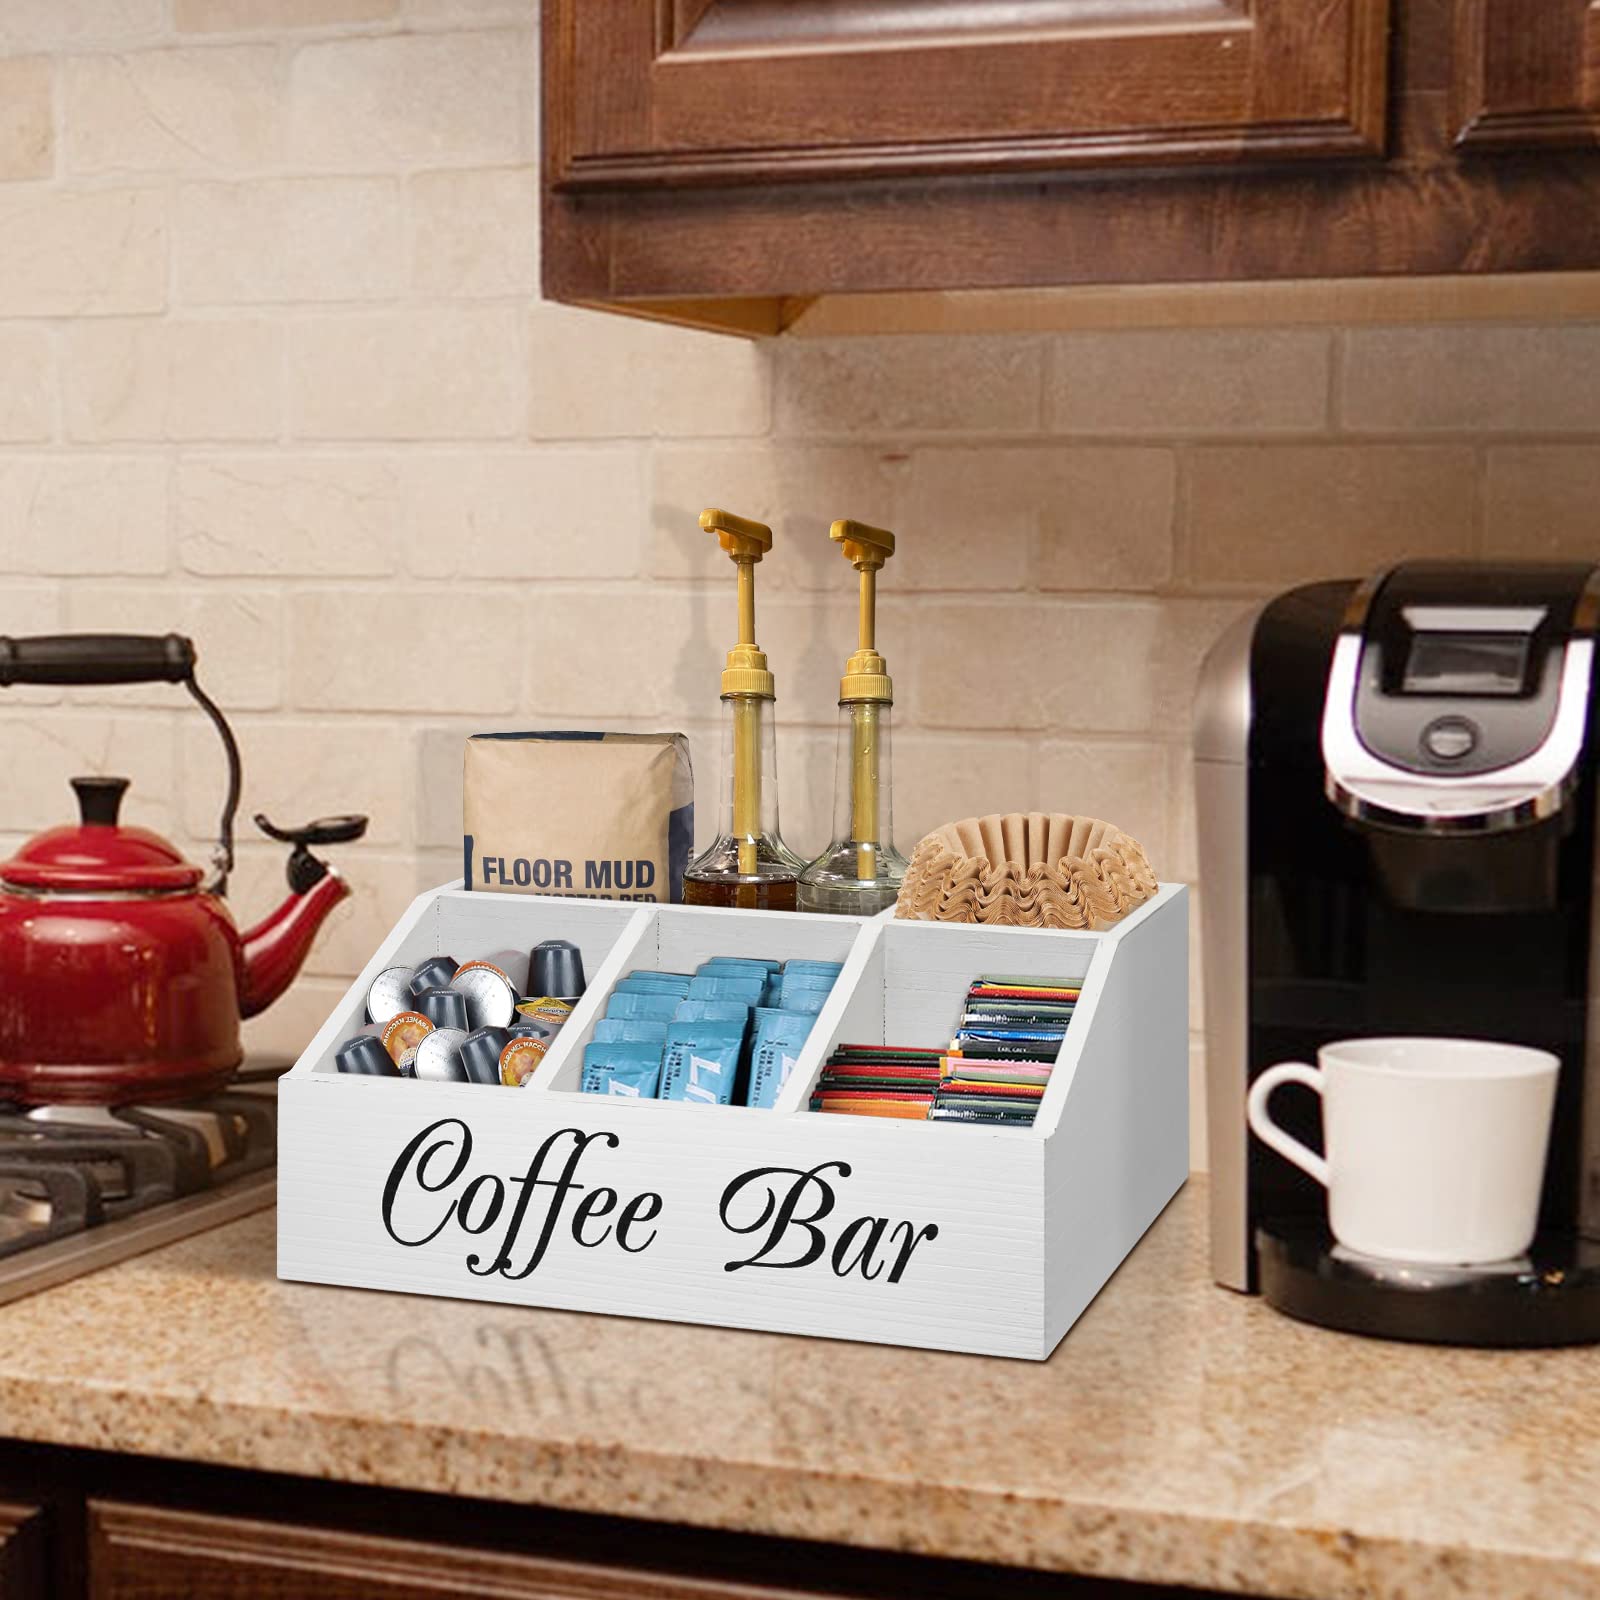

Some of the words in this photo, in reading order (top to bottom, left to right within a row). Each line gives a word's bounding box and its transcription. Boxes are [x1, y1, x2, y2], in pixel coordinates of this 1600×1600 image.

[483, 857, 572, 888] FLOOR
[586, 860, 655, 889] MUD
[523, 1041, 547, 1054] MACCH
[382, 1119, 662, 1279] Coffee
[720, 1161, 938, 1283] Bar
